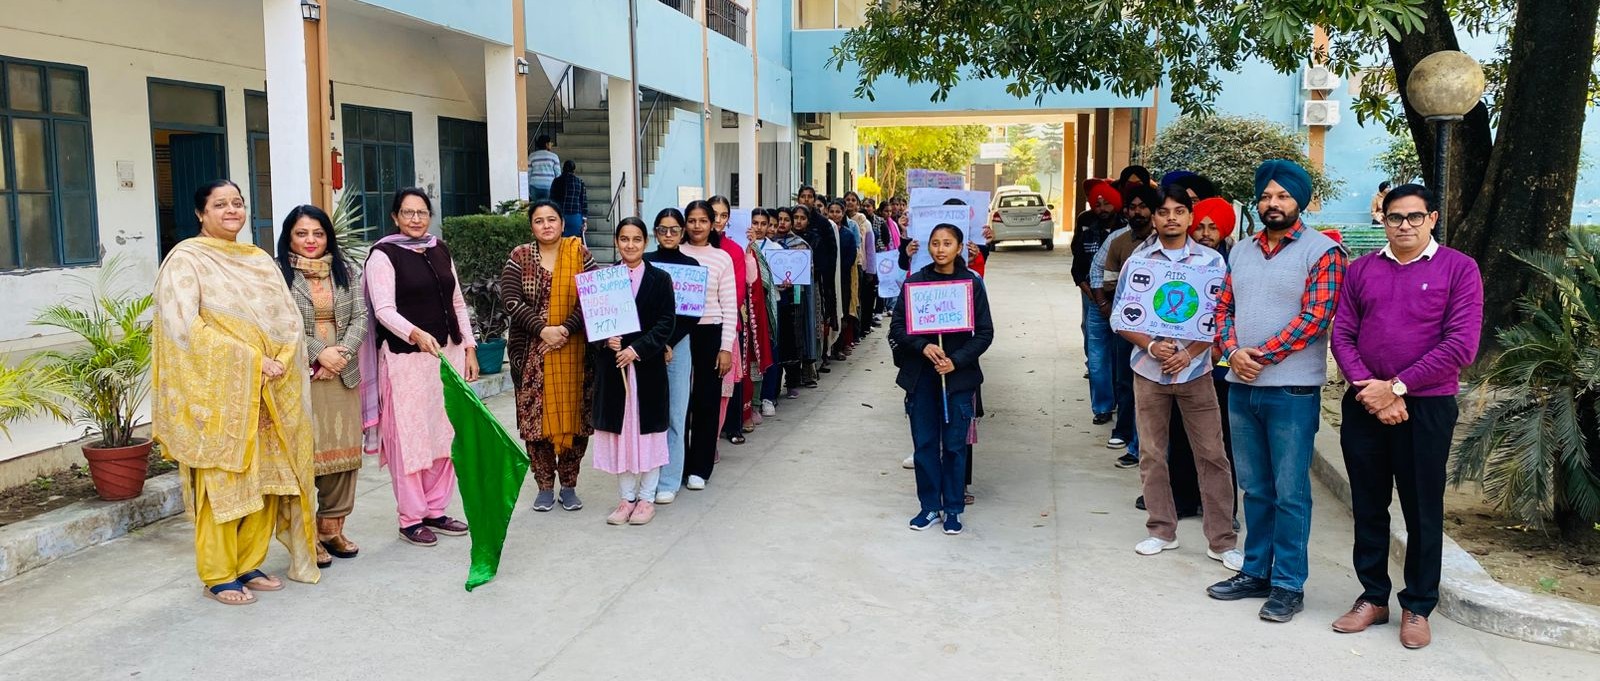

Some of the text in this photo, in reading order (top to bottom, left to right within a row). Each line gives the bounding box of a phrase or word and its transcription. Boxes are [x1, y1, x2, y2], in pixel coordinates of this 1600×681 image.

[575, 271, 594, 286] LOVE
[1164, 270, 1187, 281] AIDS
[578, 283, 598, 296] AND
[582, 294, 609, 308] THOSE
[916, 300, 956, 314] WE WILL
[584, 304, 618, 319] LIVING
[919, 310, 963, 326] END AIDS
[594, 318, 617, 334] HIV
